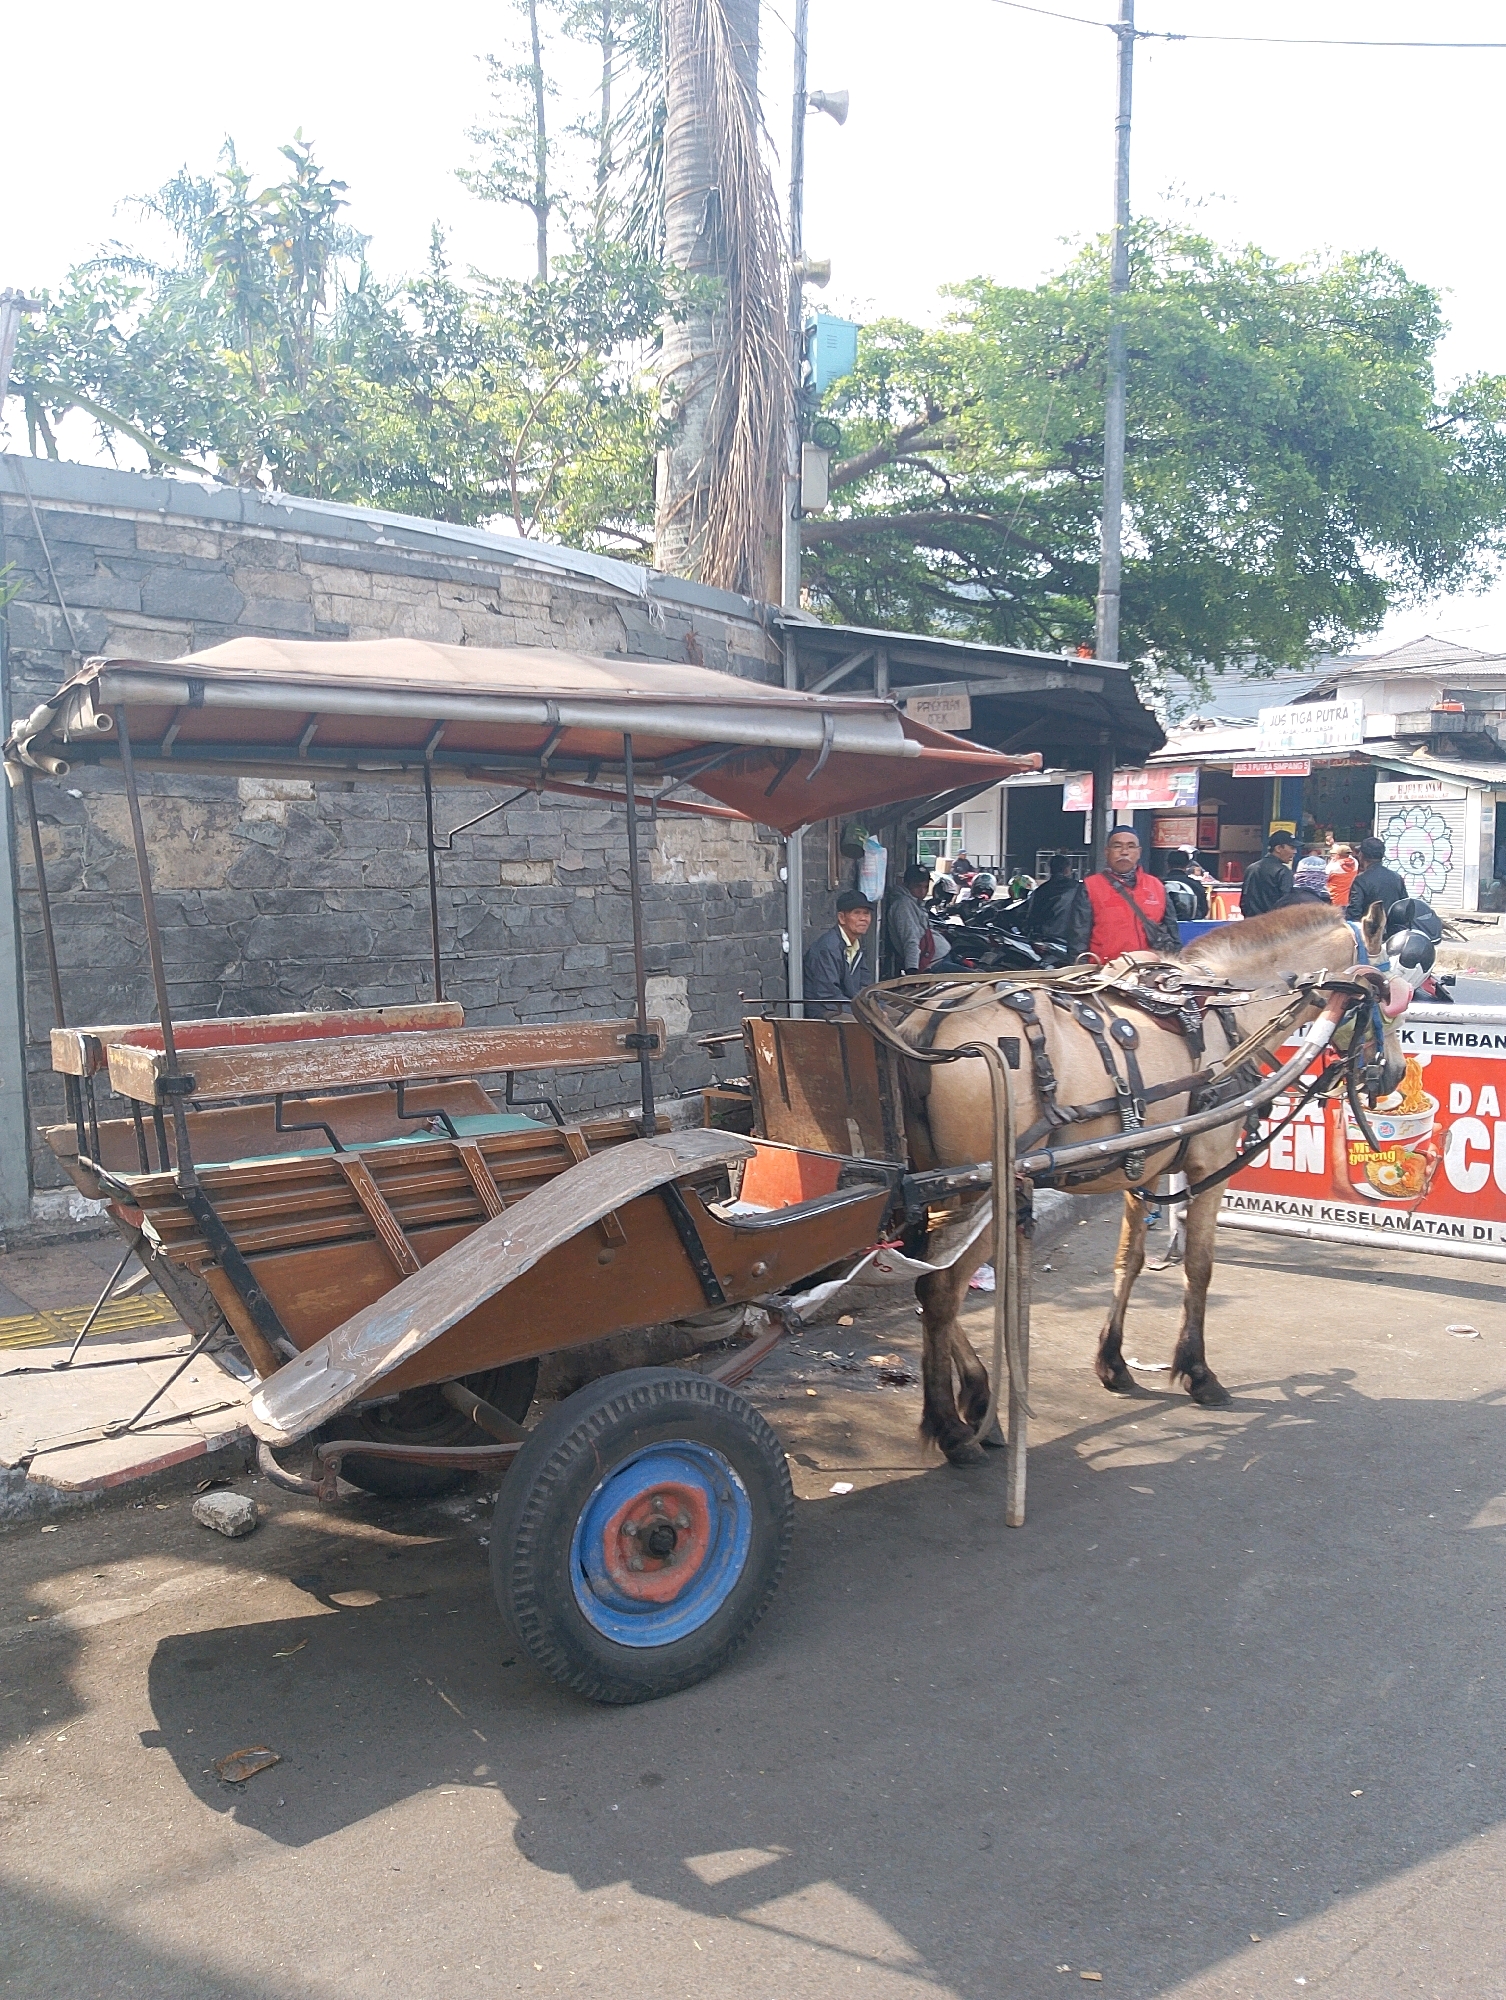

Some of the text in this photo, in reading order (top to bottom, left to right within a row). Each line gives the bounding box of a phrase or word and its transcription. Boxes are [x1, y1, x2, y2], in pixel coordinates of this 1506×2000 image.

[1269, 706, 1349, 727] JUS TIGA PUTRA
[1235, 763, 1247, 772] JUS
[1252, 763, 1273, 771] PUTRA
[1273, 761, 1303, 770] SIMPANG
[1422, 1031, 1506, 1049] LEMBAN
[1348, 1142, 1370, 1153] Mi
[1349, 1150, 1396, 1166] goreng
[1321, 1206, 1465, 1237] KESELAMATAN
[1472, 1225, 1493, 1241] DI
